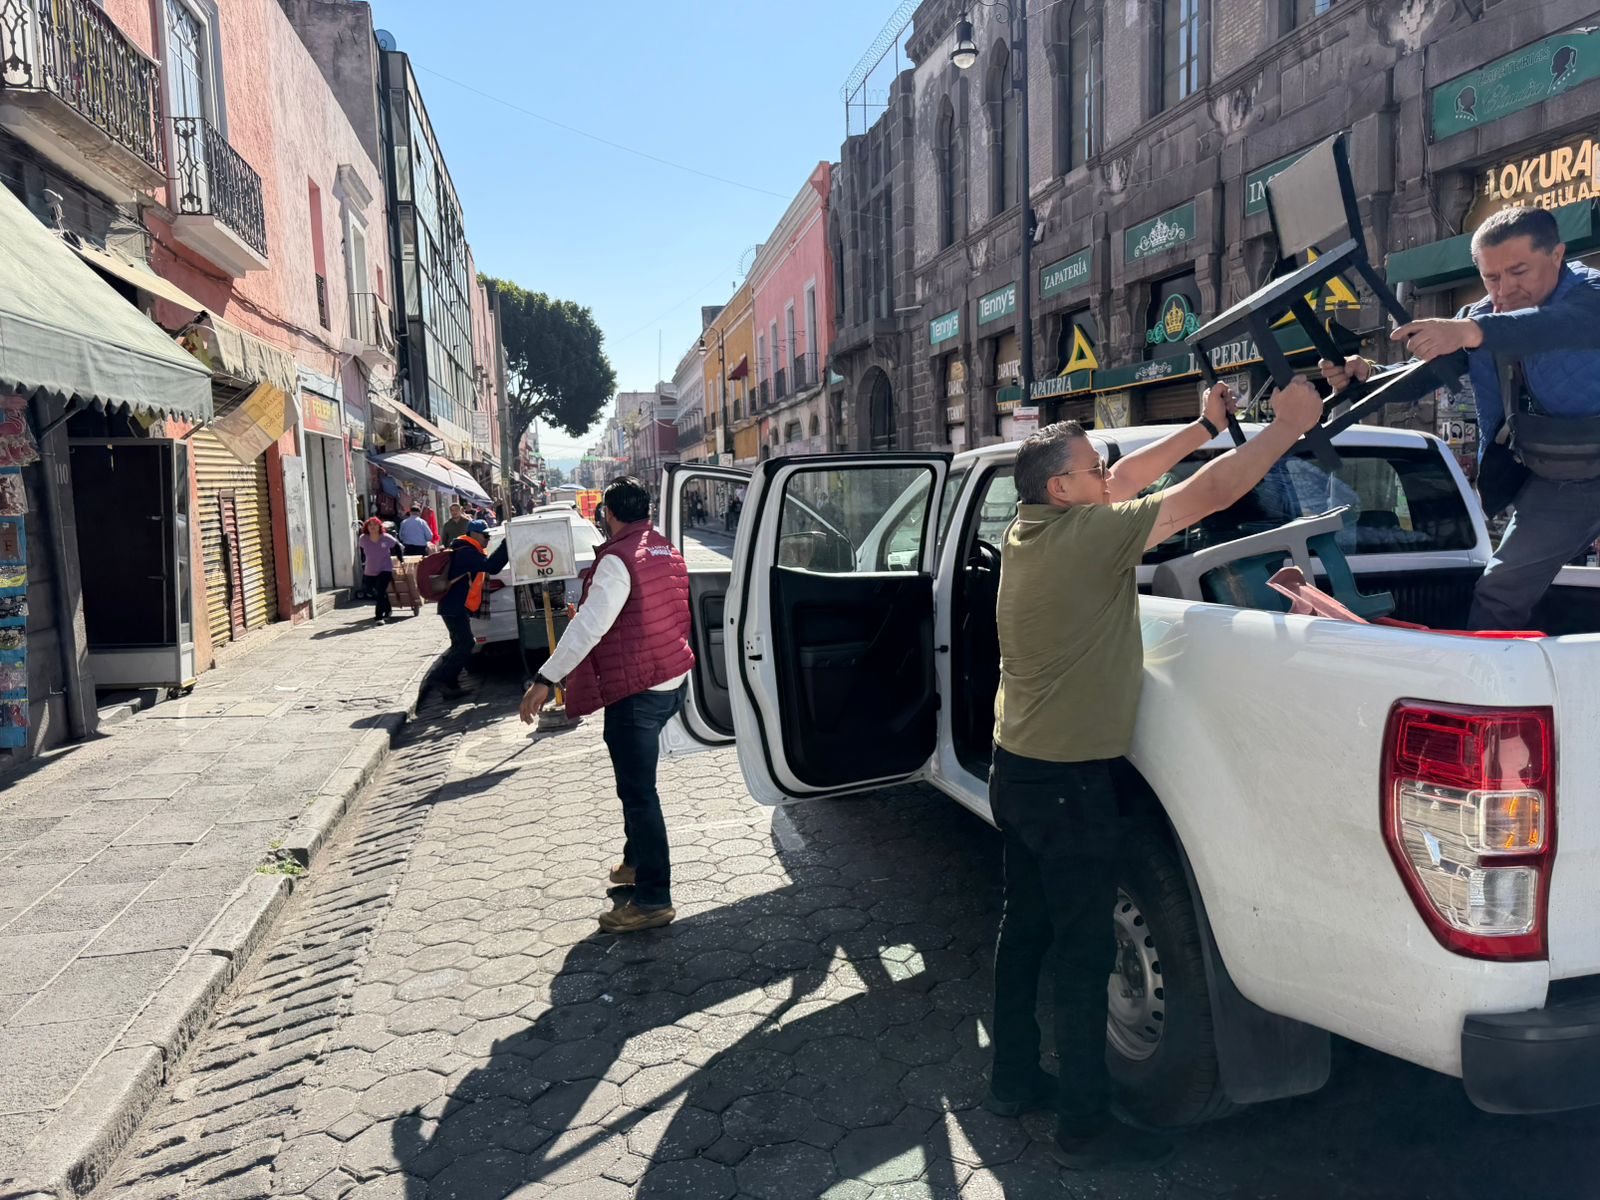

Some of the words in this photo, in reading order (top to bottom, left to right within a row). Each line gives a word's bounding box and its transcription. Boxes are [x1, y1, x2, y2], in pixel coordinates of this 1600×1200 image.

[1486, 140, 1592, 200] LOKURA
[1534, 182, 1600, 211] CELULA
[1043, 257, 1087, 290] ZAPATERÍA
[980, 289, 1015, 318] Tenny's
[931, 315, 959, 338] Tenny's
[55, 463, 69, 485] 110
[537, 567, 554, 576] NO
